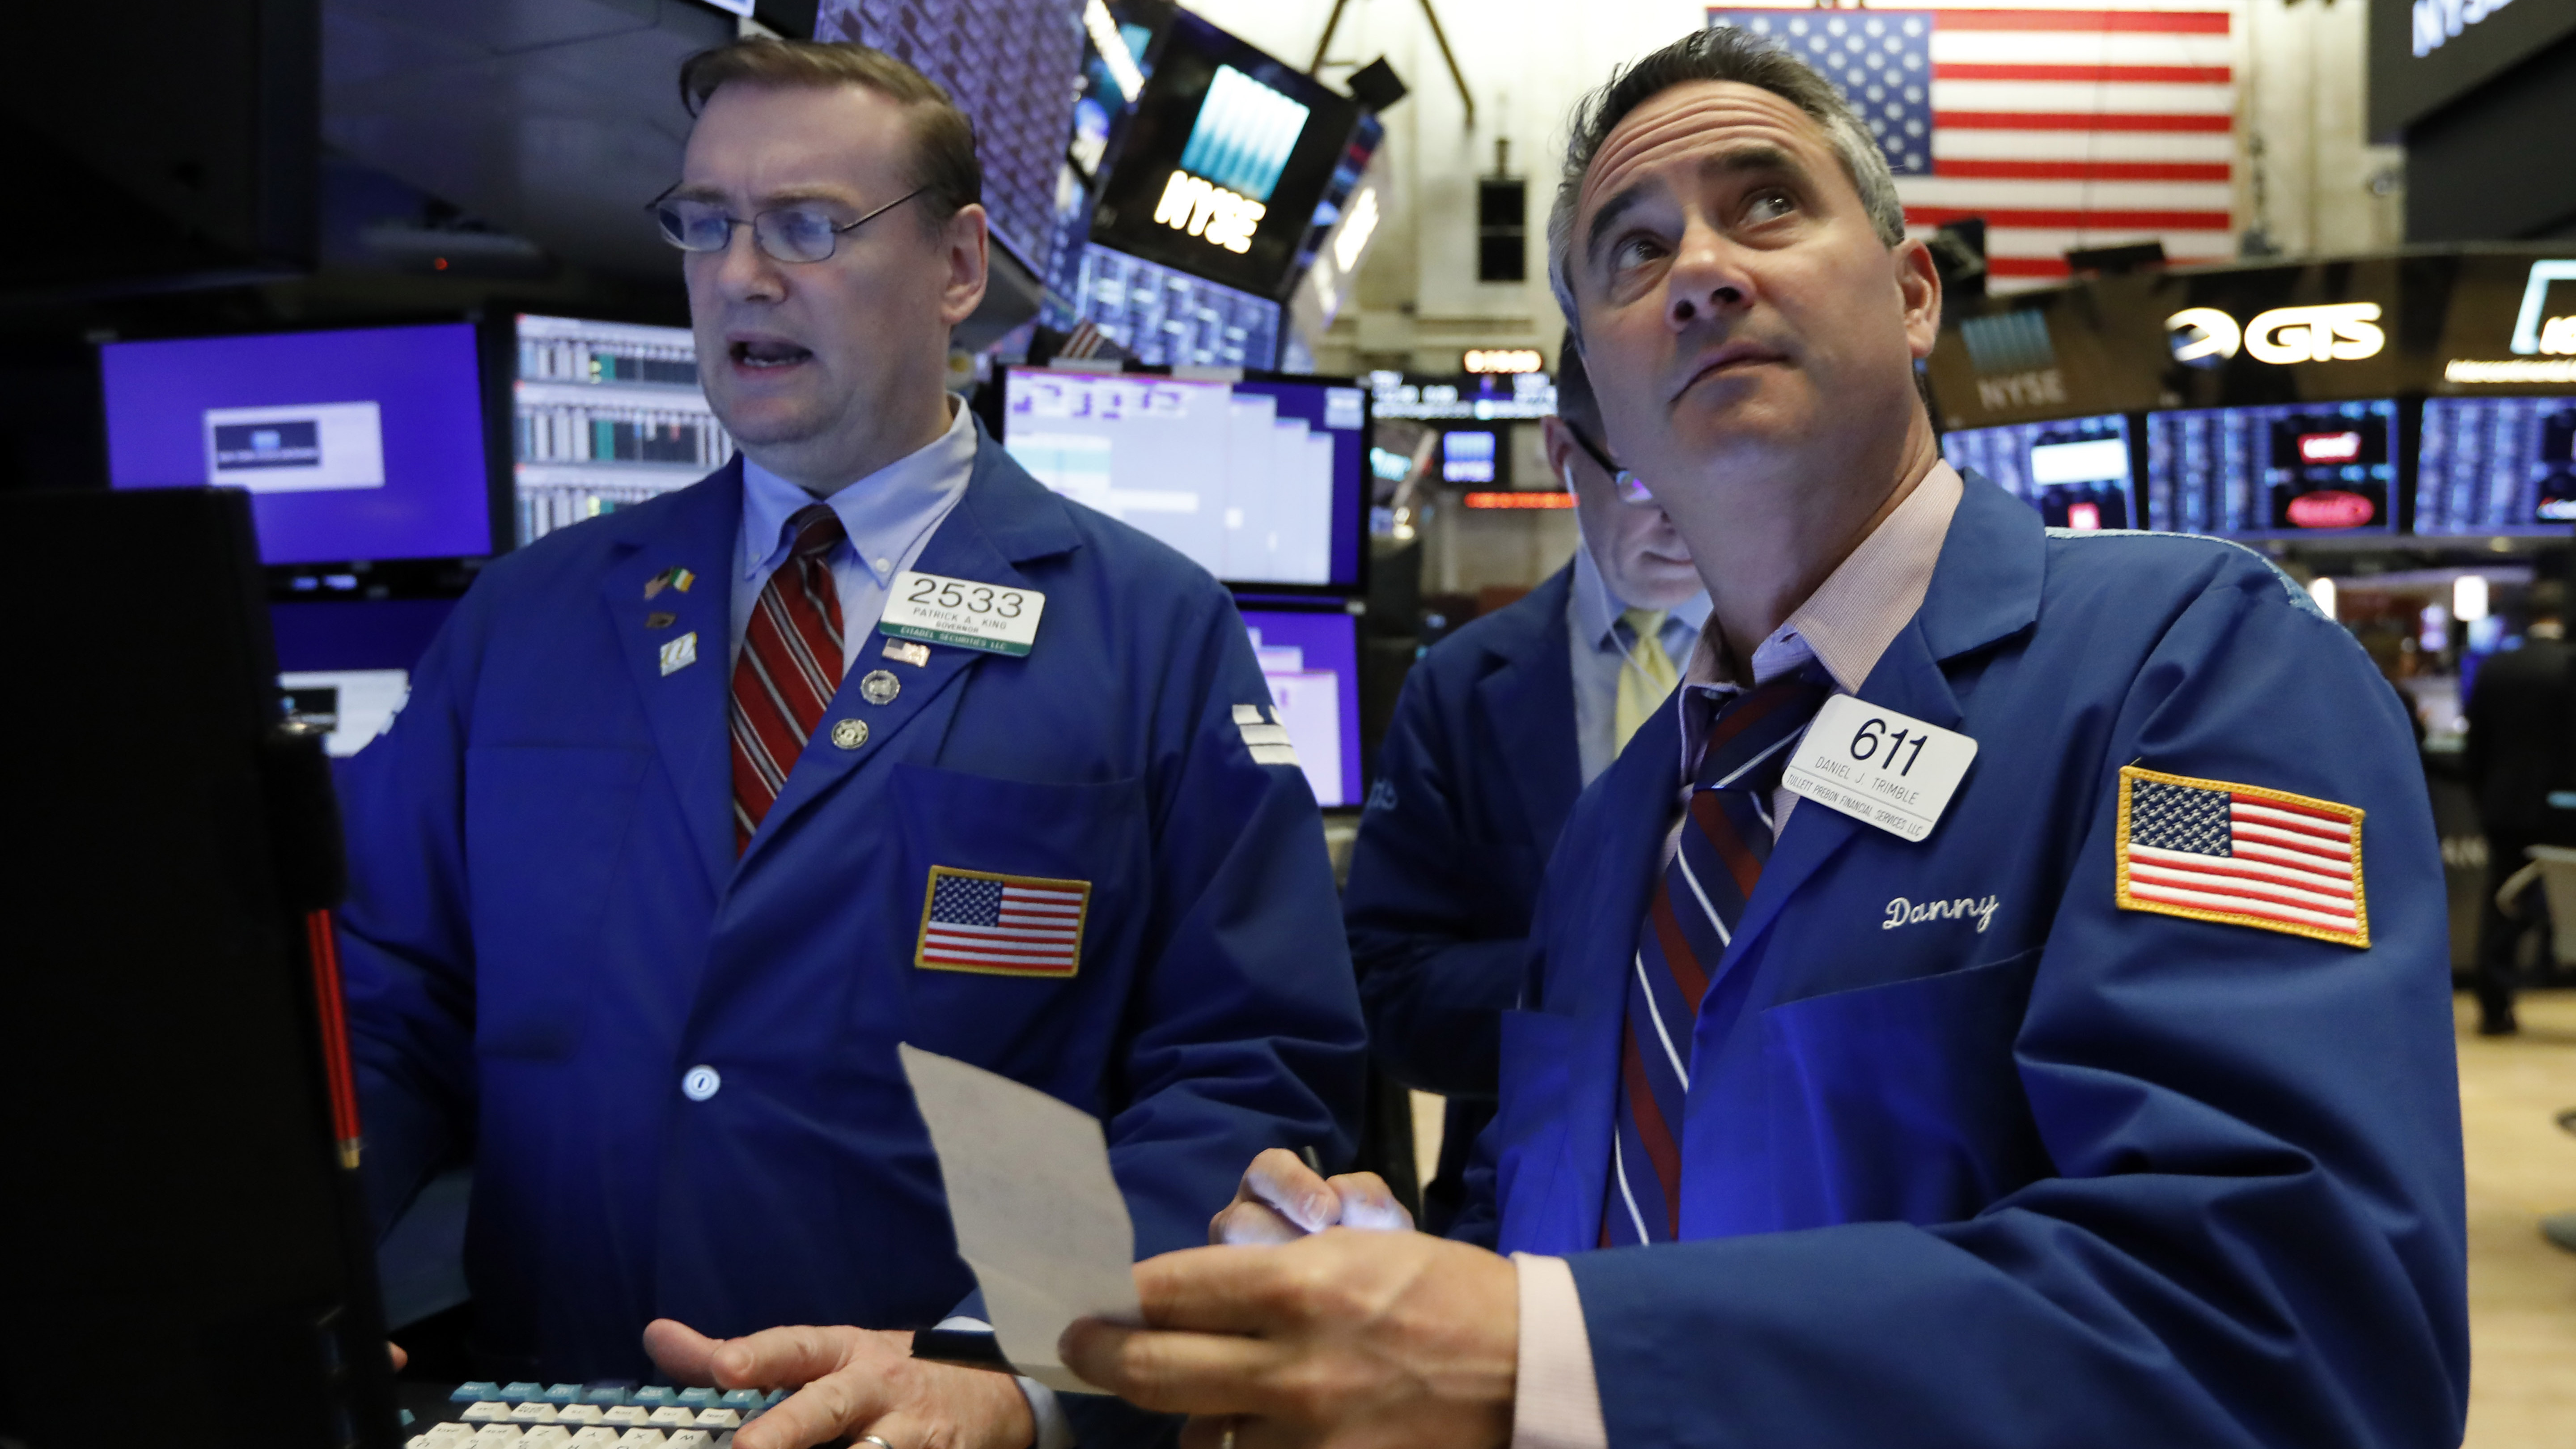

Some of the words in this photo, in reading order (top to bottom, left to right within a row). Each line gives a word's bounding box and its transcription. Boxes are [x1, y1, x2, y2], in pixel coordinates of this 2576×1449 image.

[1154, 170, 1266, 254] NYSE
[907, 578, 1023, 618] 2533
[913, 607, 958, 621] PATRICK
[982, 619, 1007, 629] KING
[900, 627, 934, 638] CITADEL
[940, 633, 986, 646] SECURITIES
[990, 642, 1006, 650] LLC
[936, 621, 979, 633] GOVERNOR
[1850, 718, 1928, 777] 611
[1815, 756, 1851, 779] DANIEL
[1871, 778, 1919, 805] TRIMBLE
[1787, 774, 1813, 791] TULLETT
[1812, 784, 1839, 802] PREBON
[1839, 795, 1873, 817] FINANCIAL
[1875, 810, 1907, 830] SERVICES
[1907, 823, 1923, 837] LLC
[1882, 895, 2000, 934] Danny
